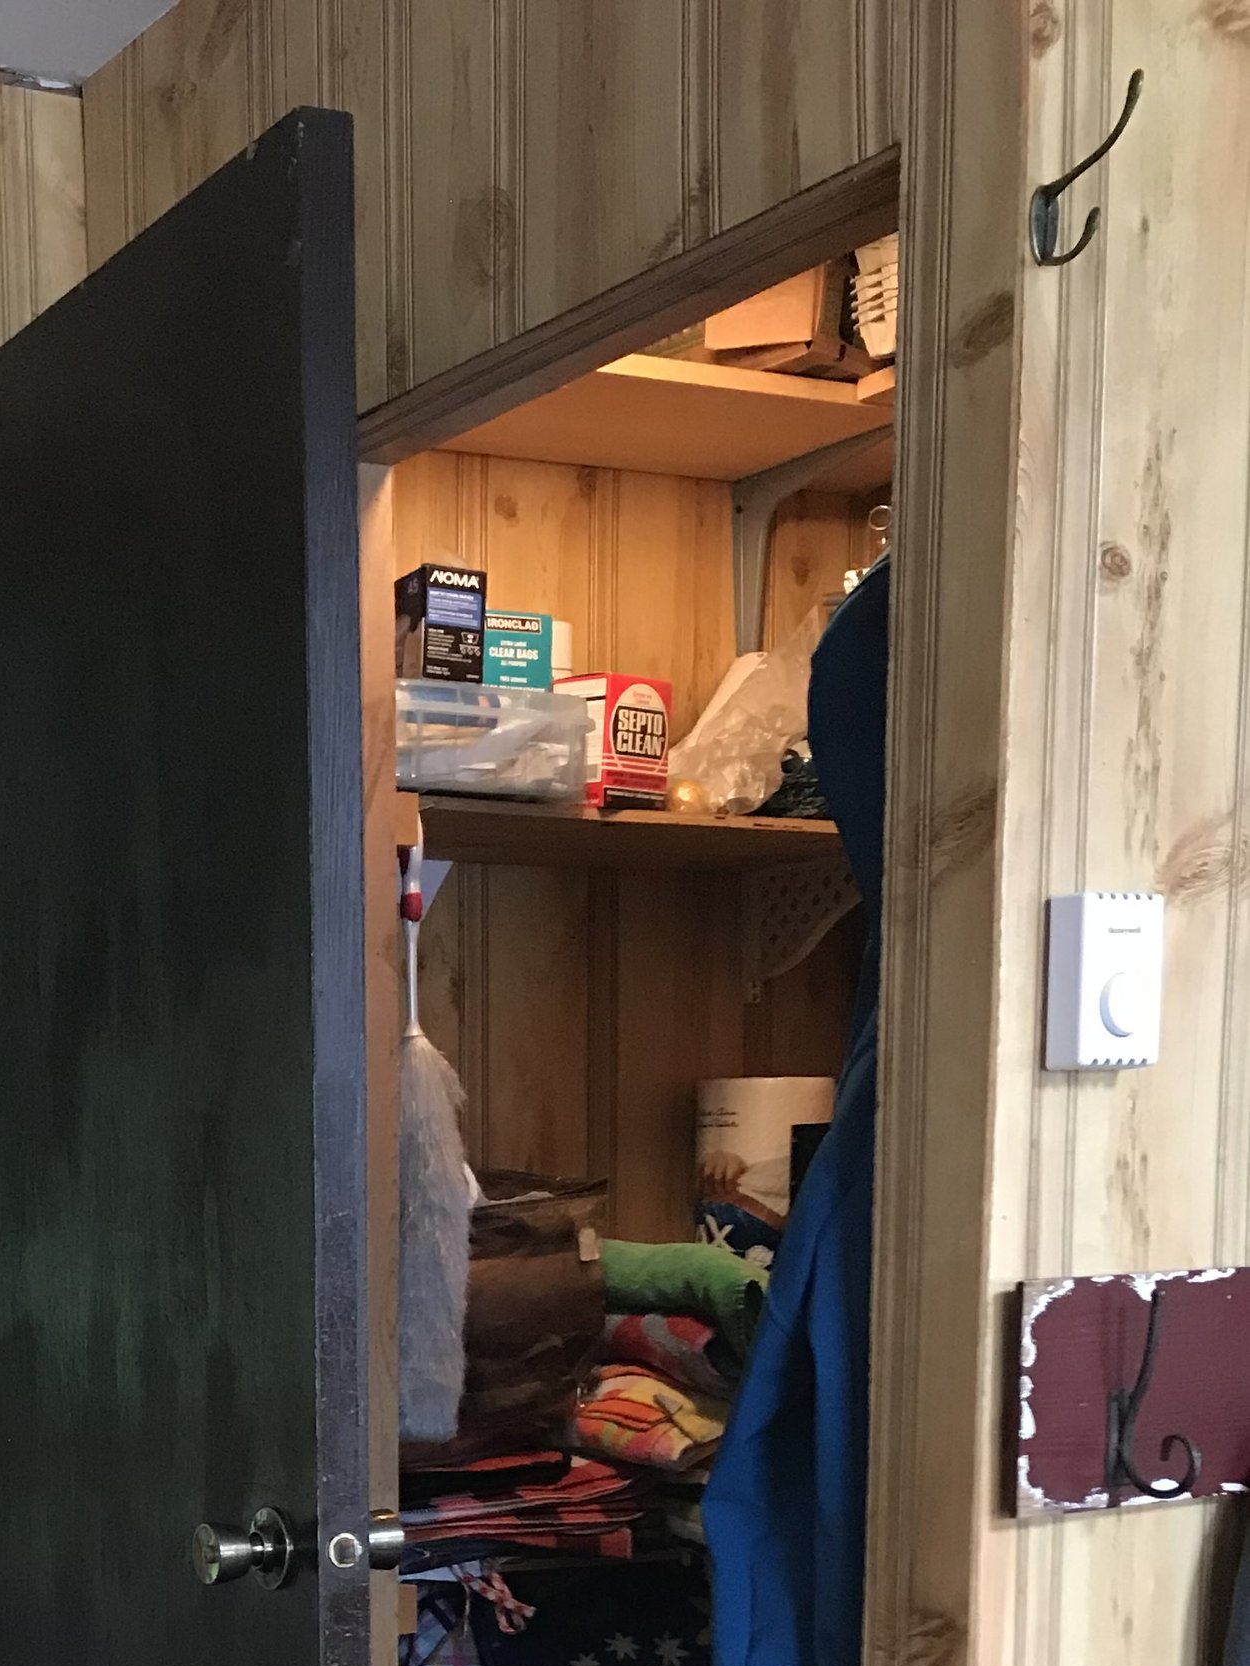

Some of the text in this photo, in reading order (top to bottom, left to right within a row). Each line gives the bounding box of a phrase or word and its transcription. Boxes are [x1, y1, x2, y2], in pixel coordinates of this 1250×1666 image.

[430, 570, 479, 589] NOMA
[487, 617, 539, 631] IRONCLAD
[489, 646, 539, 660] CLEAR BAGS
[618, 709, 663, 735] SEPTO
[617, 731, 662, 756] CLEAN
